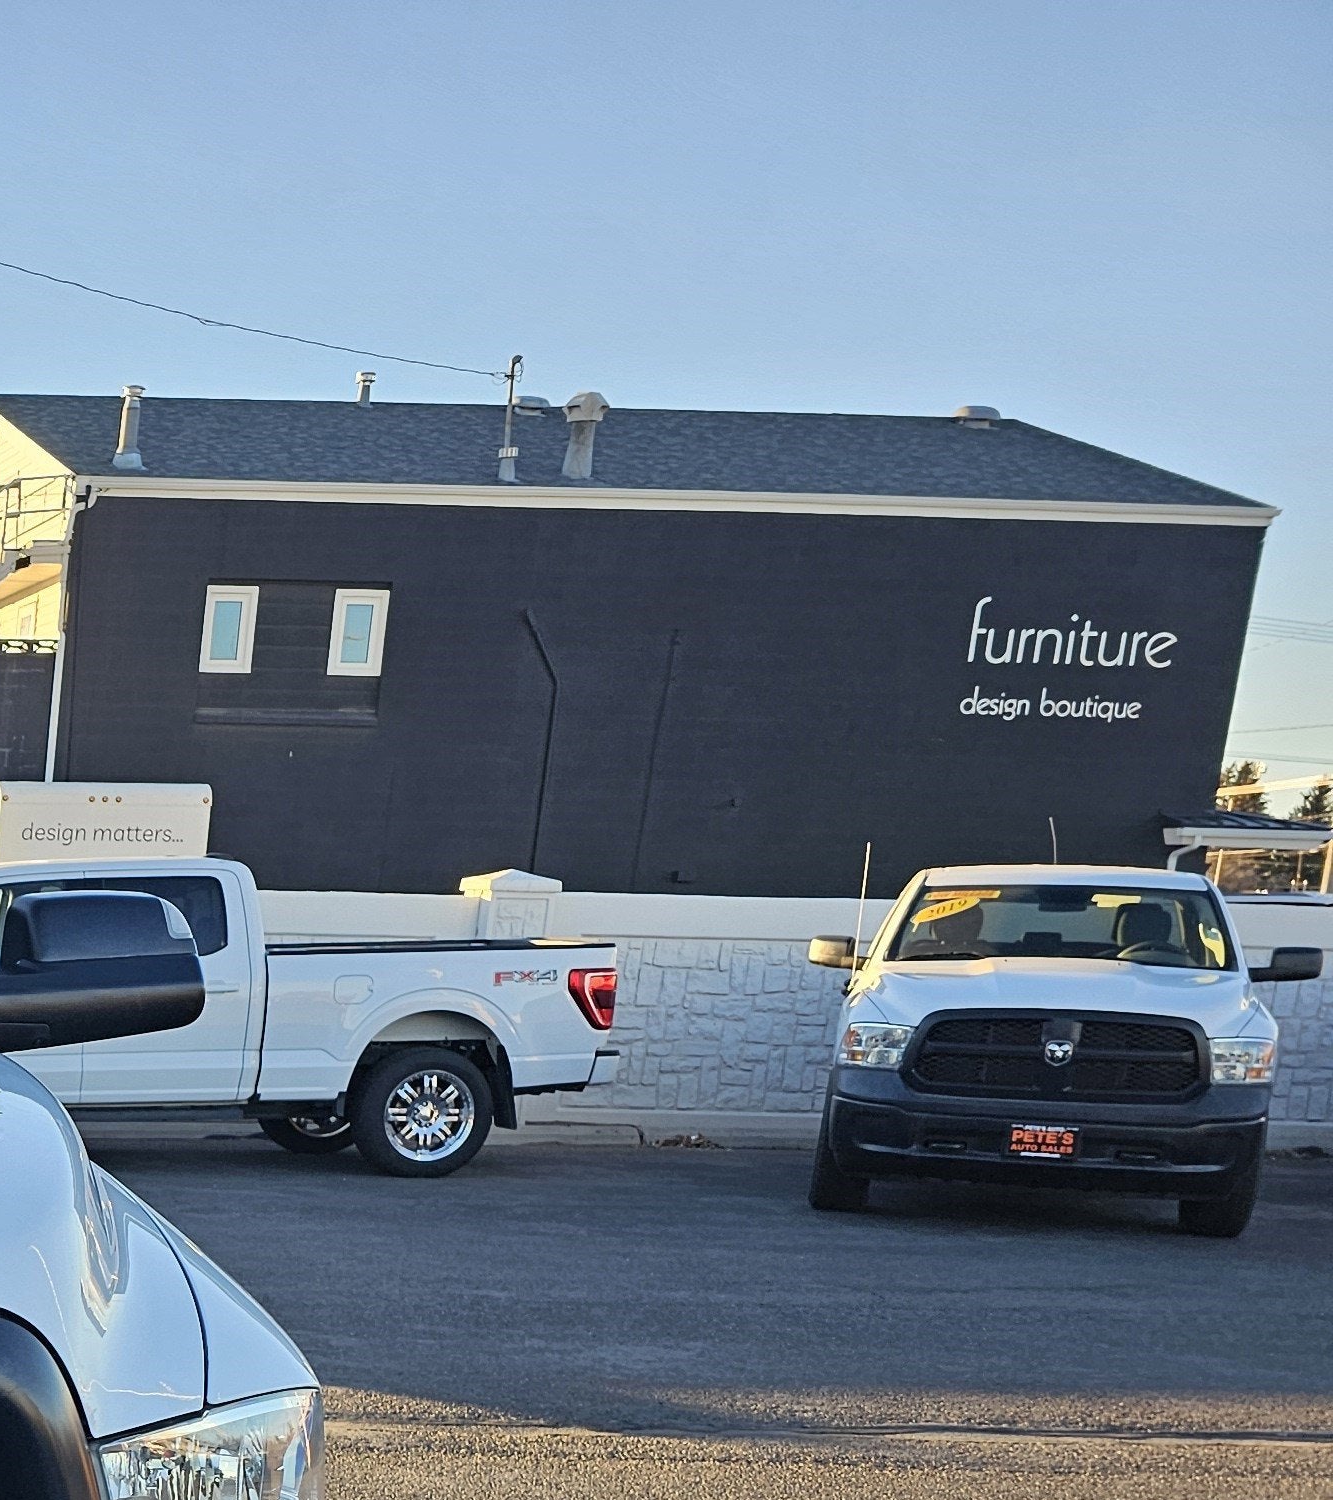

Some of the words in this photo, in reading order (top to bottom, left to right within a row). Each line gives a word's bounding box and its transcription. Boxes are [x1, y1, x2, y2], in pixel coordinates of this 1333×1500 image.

[967, 596, 1178, 669] furniture
[959, 685, 1031, 721] design
[1039, 686, 1142, 723] boutique
[21, 822, 86, 846] design
[493, 969, 558, 986] FX4
[1012, 1130, 1074, 1145] PETE'S
